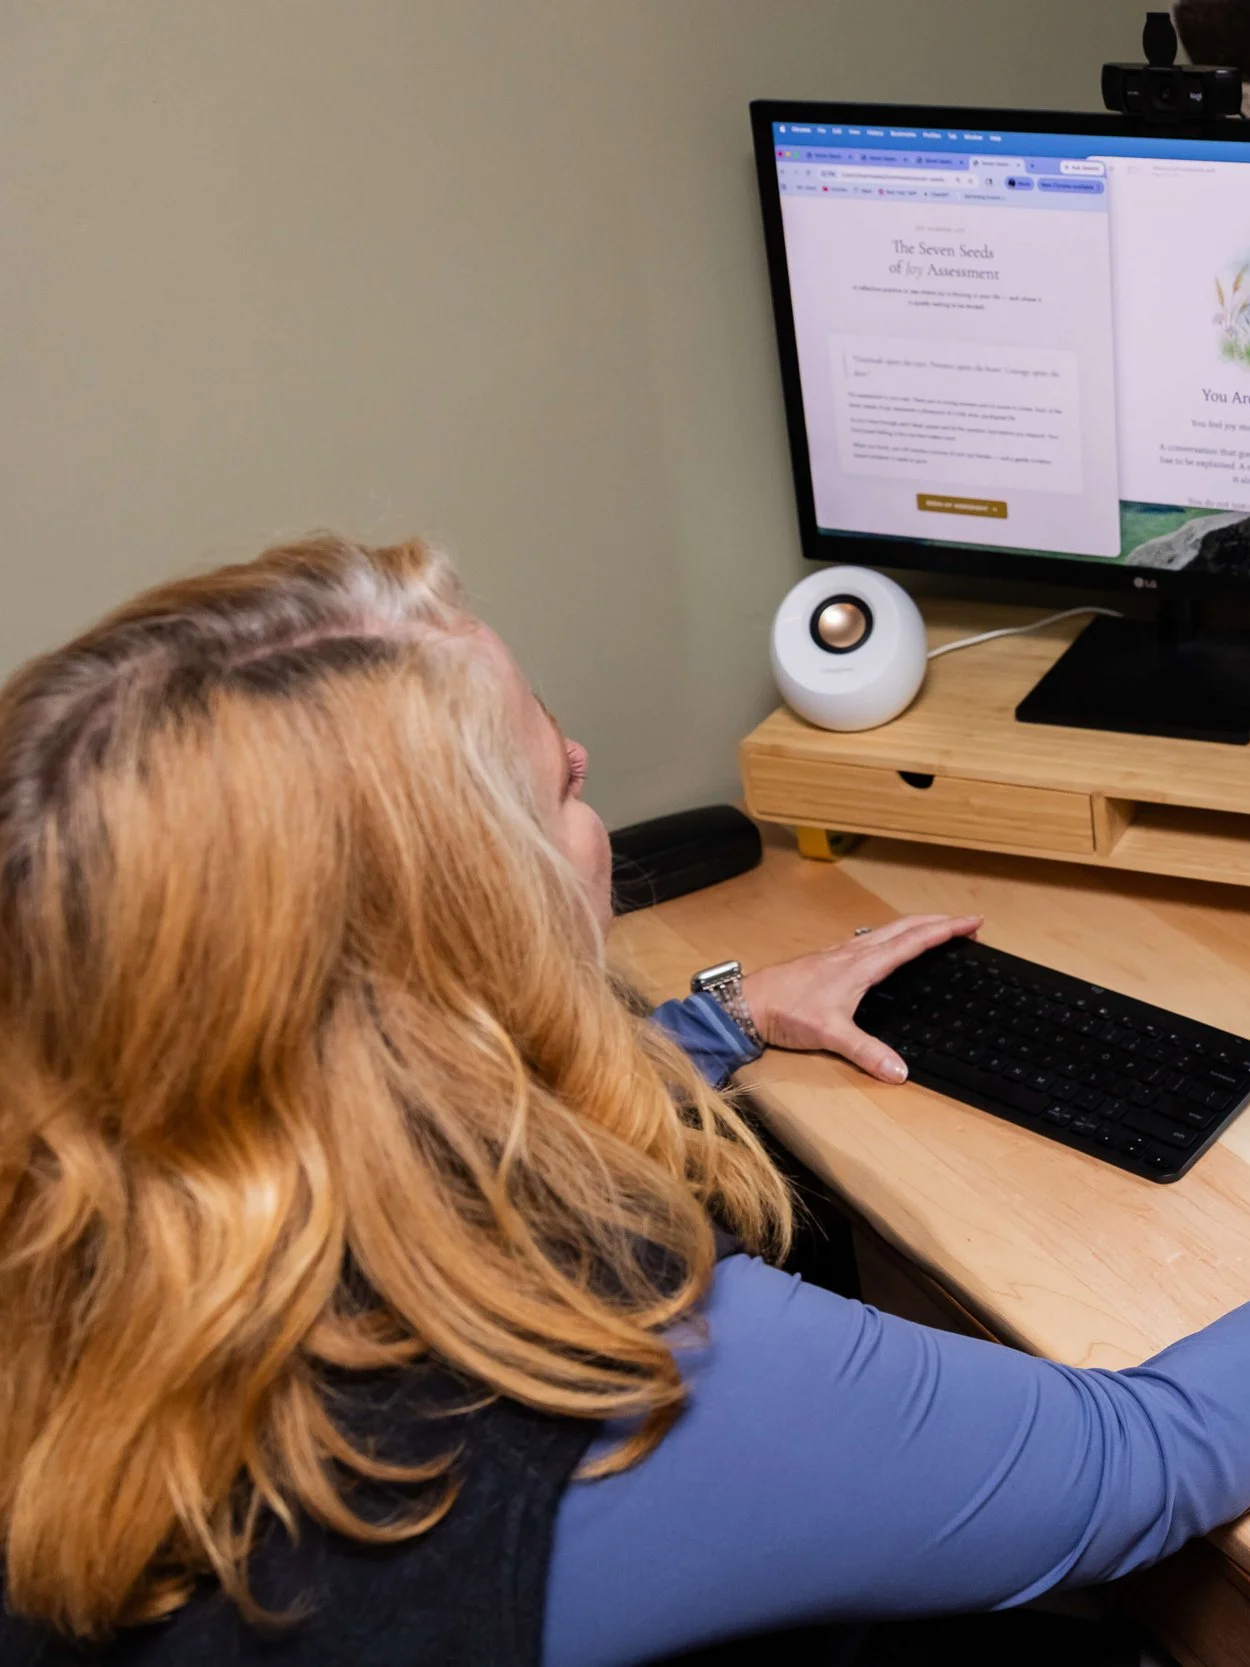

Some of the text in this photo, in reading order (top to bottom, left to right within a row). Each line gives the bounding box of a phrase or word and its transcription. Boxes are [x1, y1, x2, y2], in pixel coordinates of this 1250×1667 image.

[892, 239, 994, 259] The Seven Seeds
[888, 258, 904, 275] of
[927, 263, 1000, 280] Assessment
[1202, 388, 1227, 404] You
[1191, 419, 1207, 428] You
[1208, 419, 1223, 429] feel
[1224, 423, 1236, 433] joy
[1159, 443, 1166, 451] A
[1219, 447, 1236, 457] that
